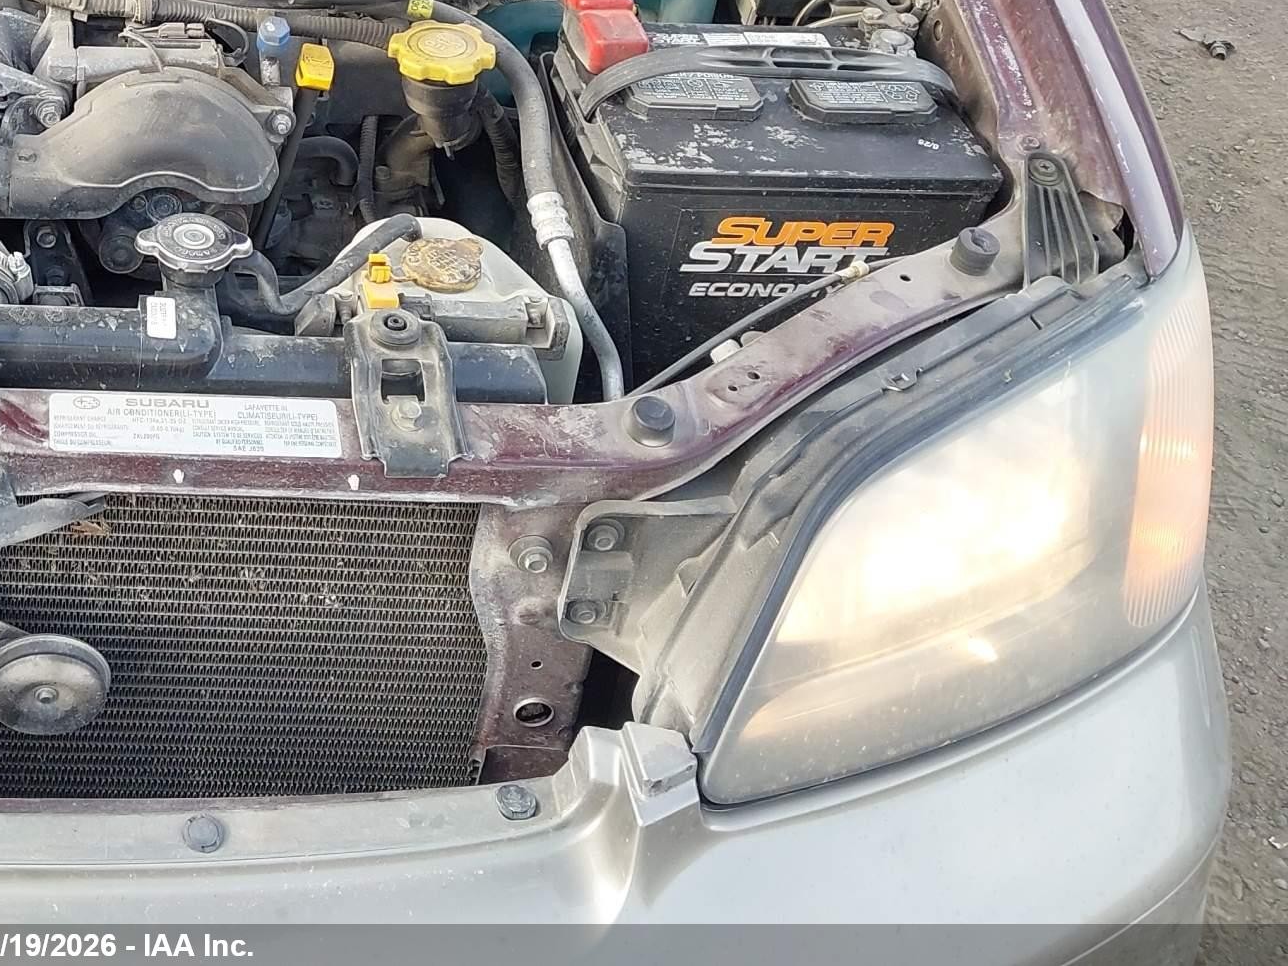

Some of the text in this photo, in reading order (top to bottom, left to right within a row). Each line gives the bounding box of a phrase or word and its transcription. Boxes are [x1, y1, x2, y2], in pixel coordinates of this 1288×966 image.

[711, 216, 894, 247] SUPER
[679, 240, 888, 273] START
[688, 282, 844, 298] ECONOY
[107, 407, 121, 416] AIR
[126, 398, 210, 409] SUBARU
